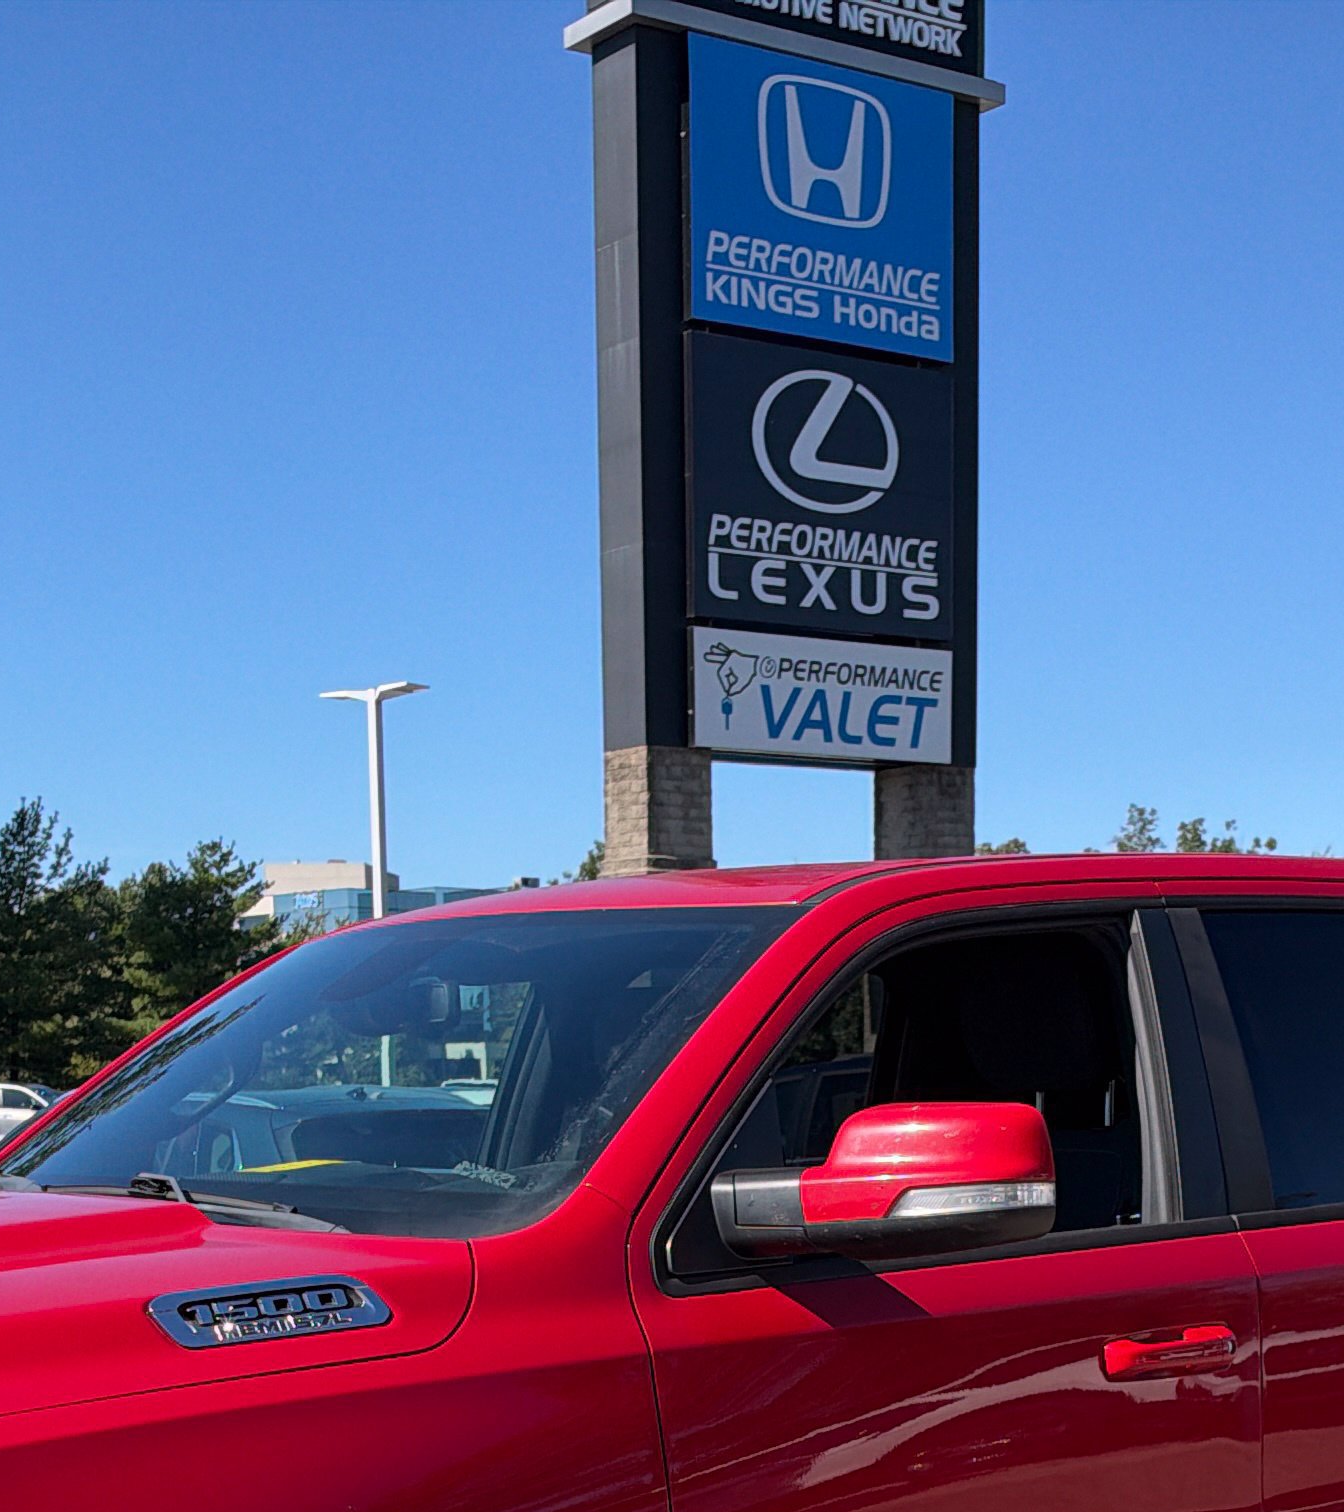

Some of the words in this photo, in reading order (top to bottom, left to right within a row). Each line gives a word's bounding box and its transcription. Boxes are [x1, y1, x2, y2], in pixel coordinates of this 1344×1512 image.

[838, 1, 963, 57] NETWORK
[706, 230, 941, 302] PERFORMANCE
[705, 271, 820, 319] KINGS
[833, 299, 940, 341] Honda
[708, 513, 938, 571] PERFORMANCE
[707, 552, 940, 620] LEXUS
[776, 658, 944, 693] PERFORMANCE
[760, 684, 939, 750] VALET
[186, 1288, 349, 1327] 1500
